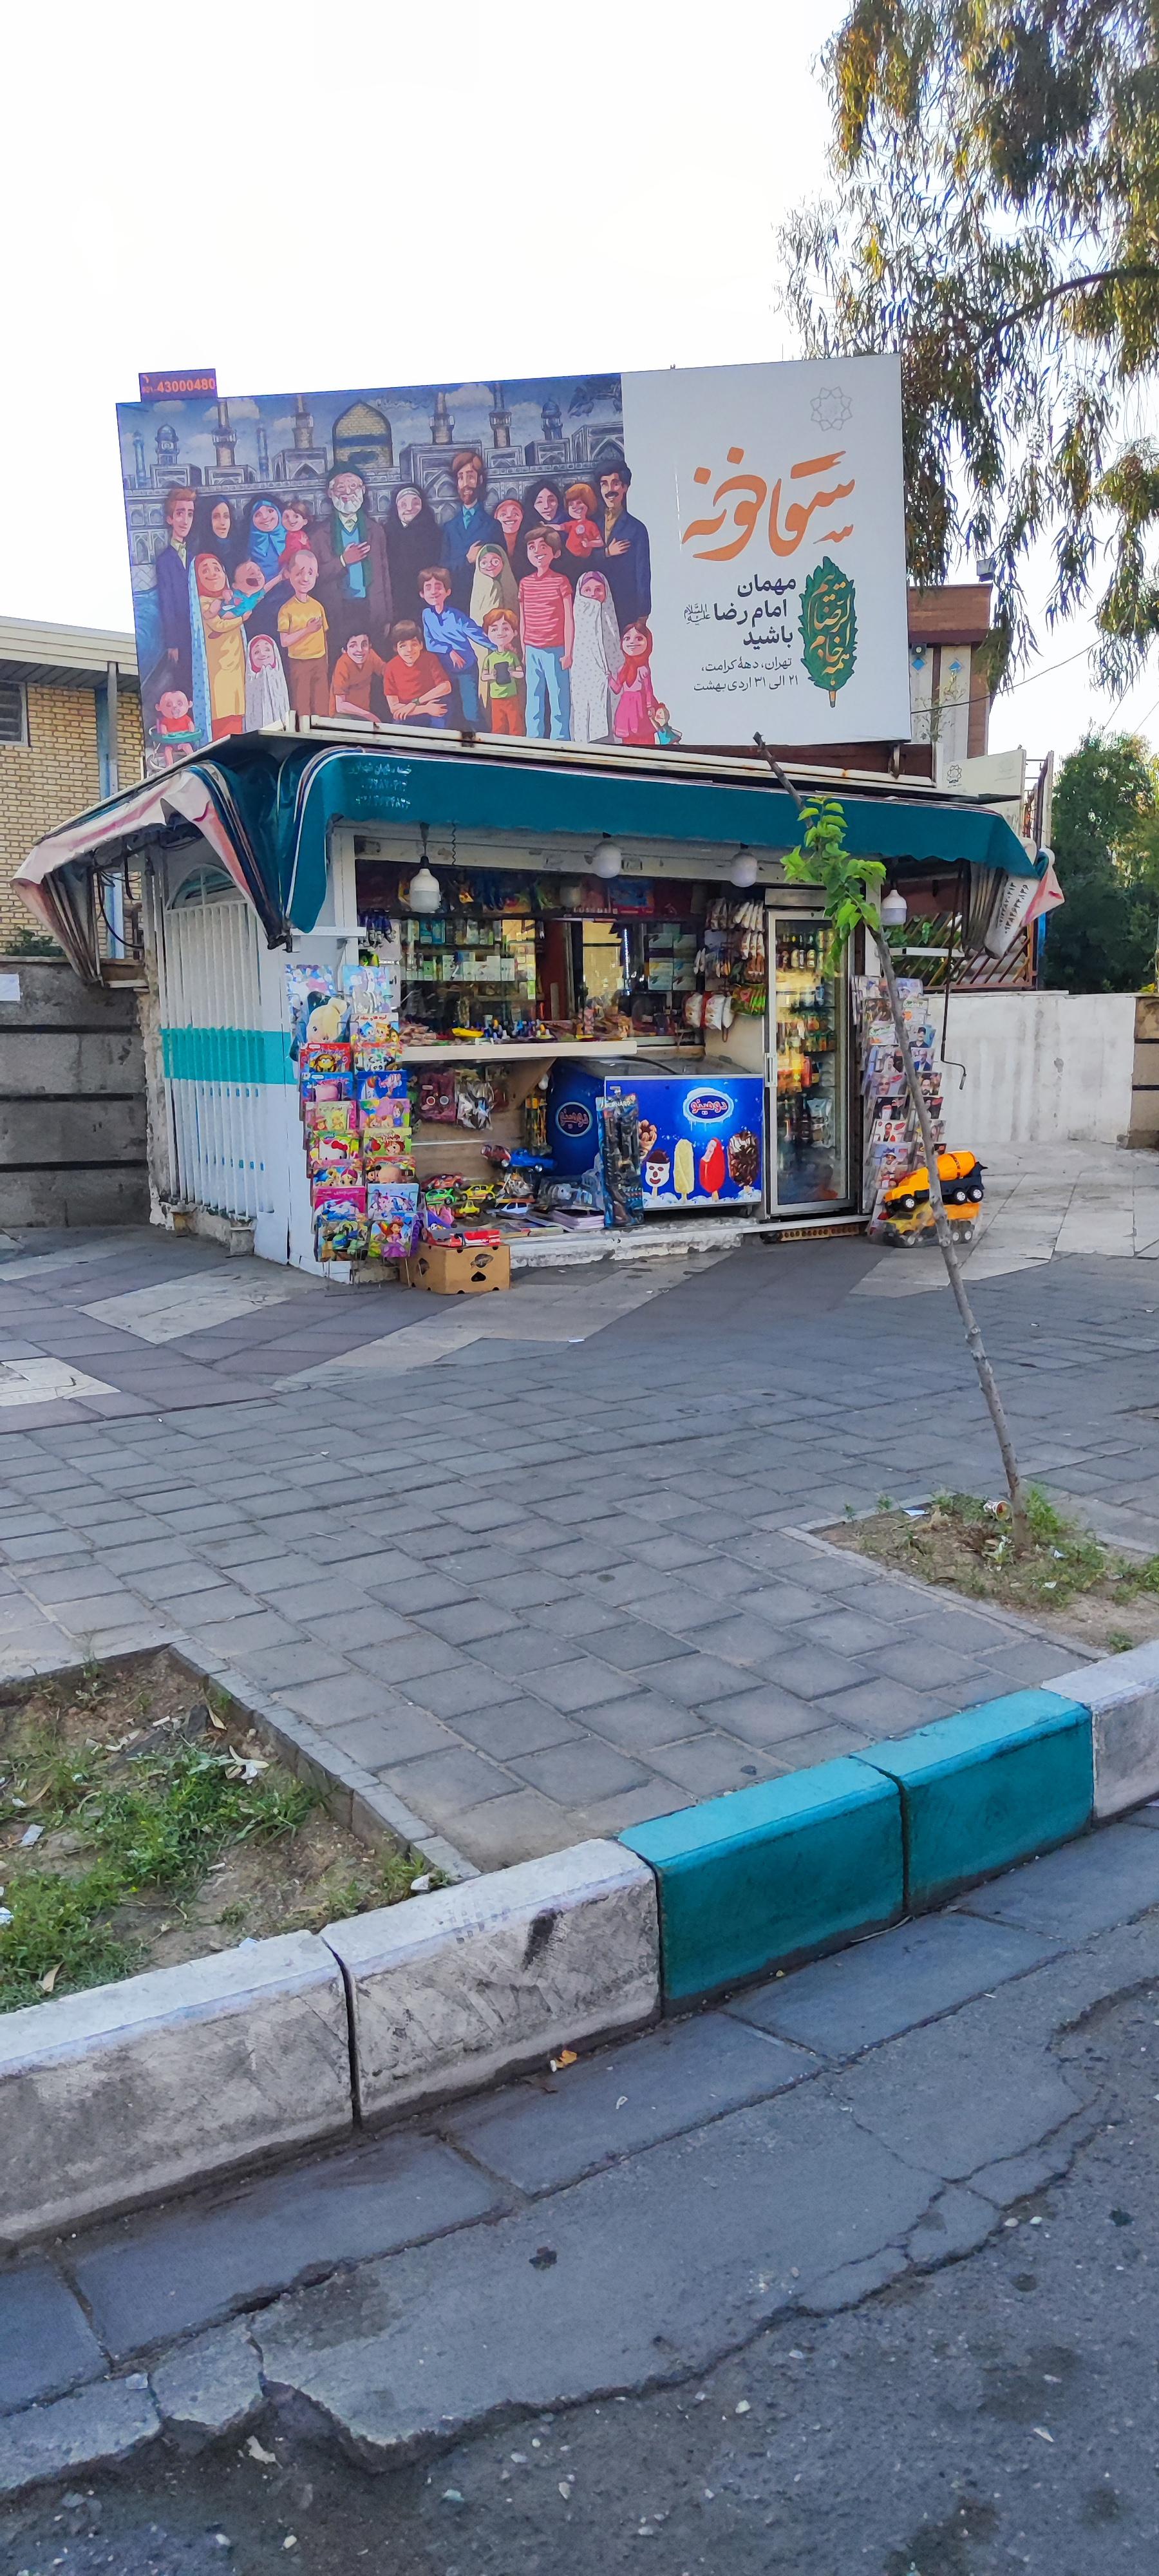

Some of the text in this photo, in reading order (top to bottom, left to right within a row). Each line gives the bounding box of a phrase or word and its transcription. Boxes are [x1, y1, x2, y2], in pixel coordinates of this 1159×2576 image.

[737, 573, 796, 597] مهمان
[713, 602, 748, 625] رضا
[751, 599, 787, 628] امام
[743, 625, 793, 650] باشید
[754, 676, 766, 688] ۳۱
[769, 674, 785, 690] الی
[789, 674, 798, 686] ۲۱
[690, 1098, 728, 1115] دومینو
[559, 1108, 589, 1129] دومینو
